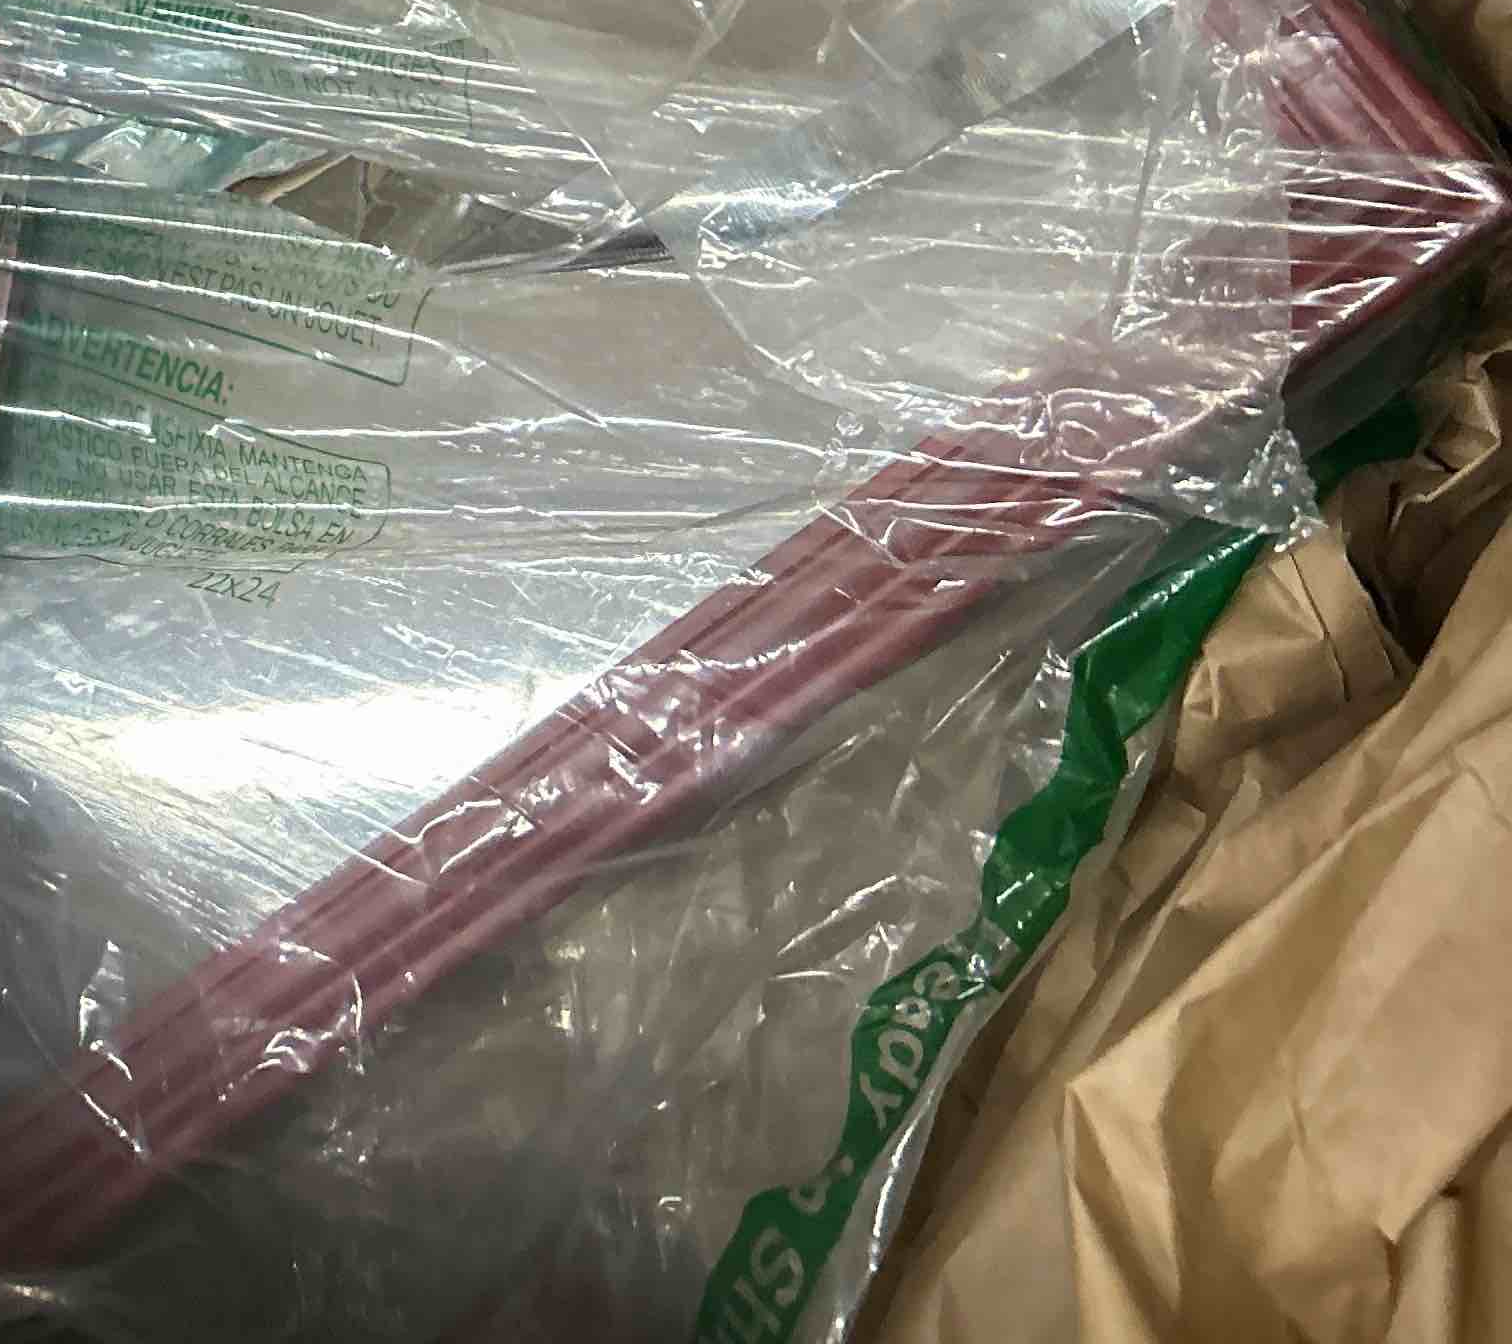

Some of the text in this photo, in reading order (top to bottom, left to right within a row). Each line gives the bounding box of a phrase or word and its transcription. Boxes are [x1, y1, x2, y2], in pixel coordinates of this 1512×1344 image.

[119, 467, 178, 498] USAR
[316, 518, 355, 545] EN
[238, 441, 369, 484] MANTENGA
[858, 955, 970, 1130] eady
[714, 1225, 806, 1344] Sh
